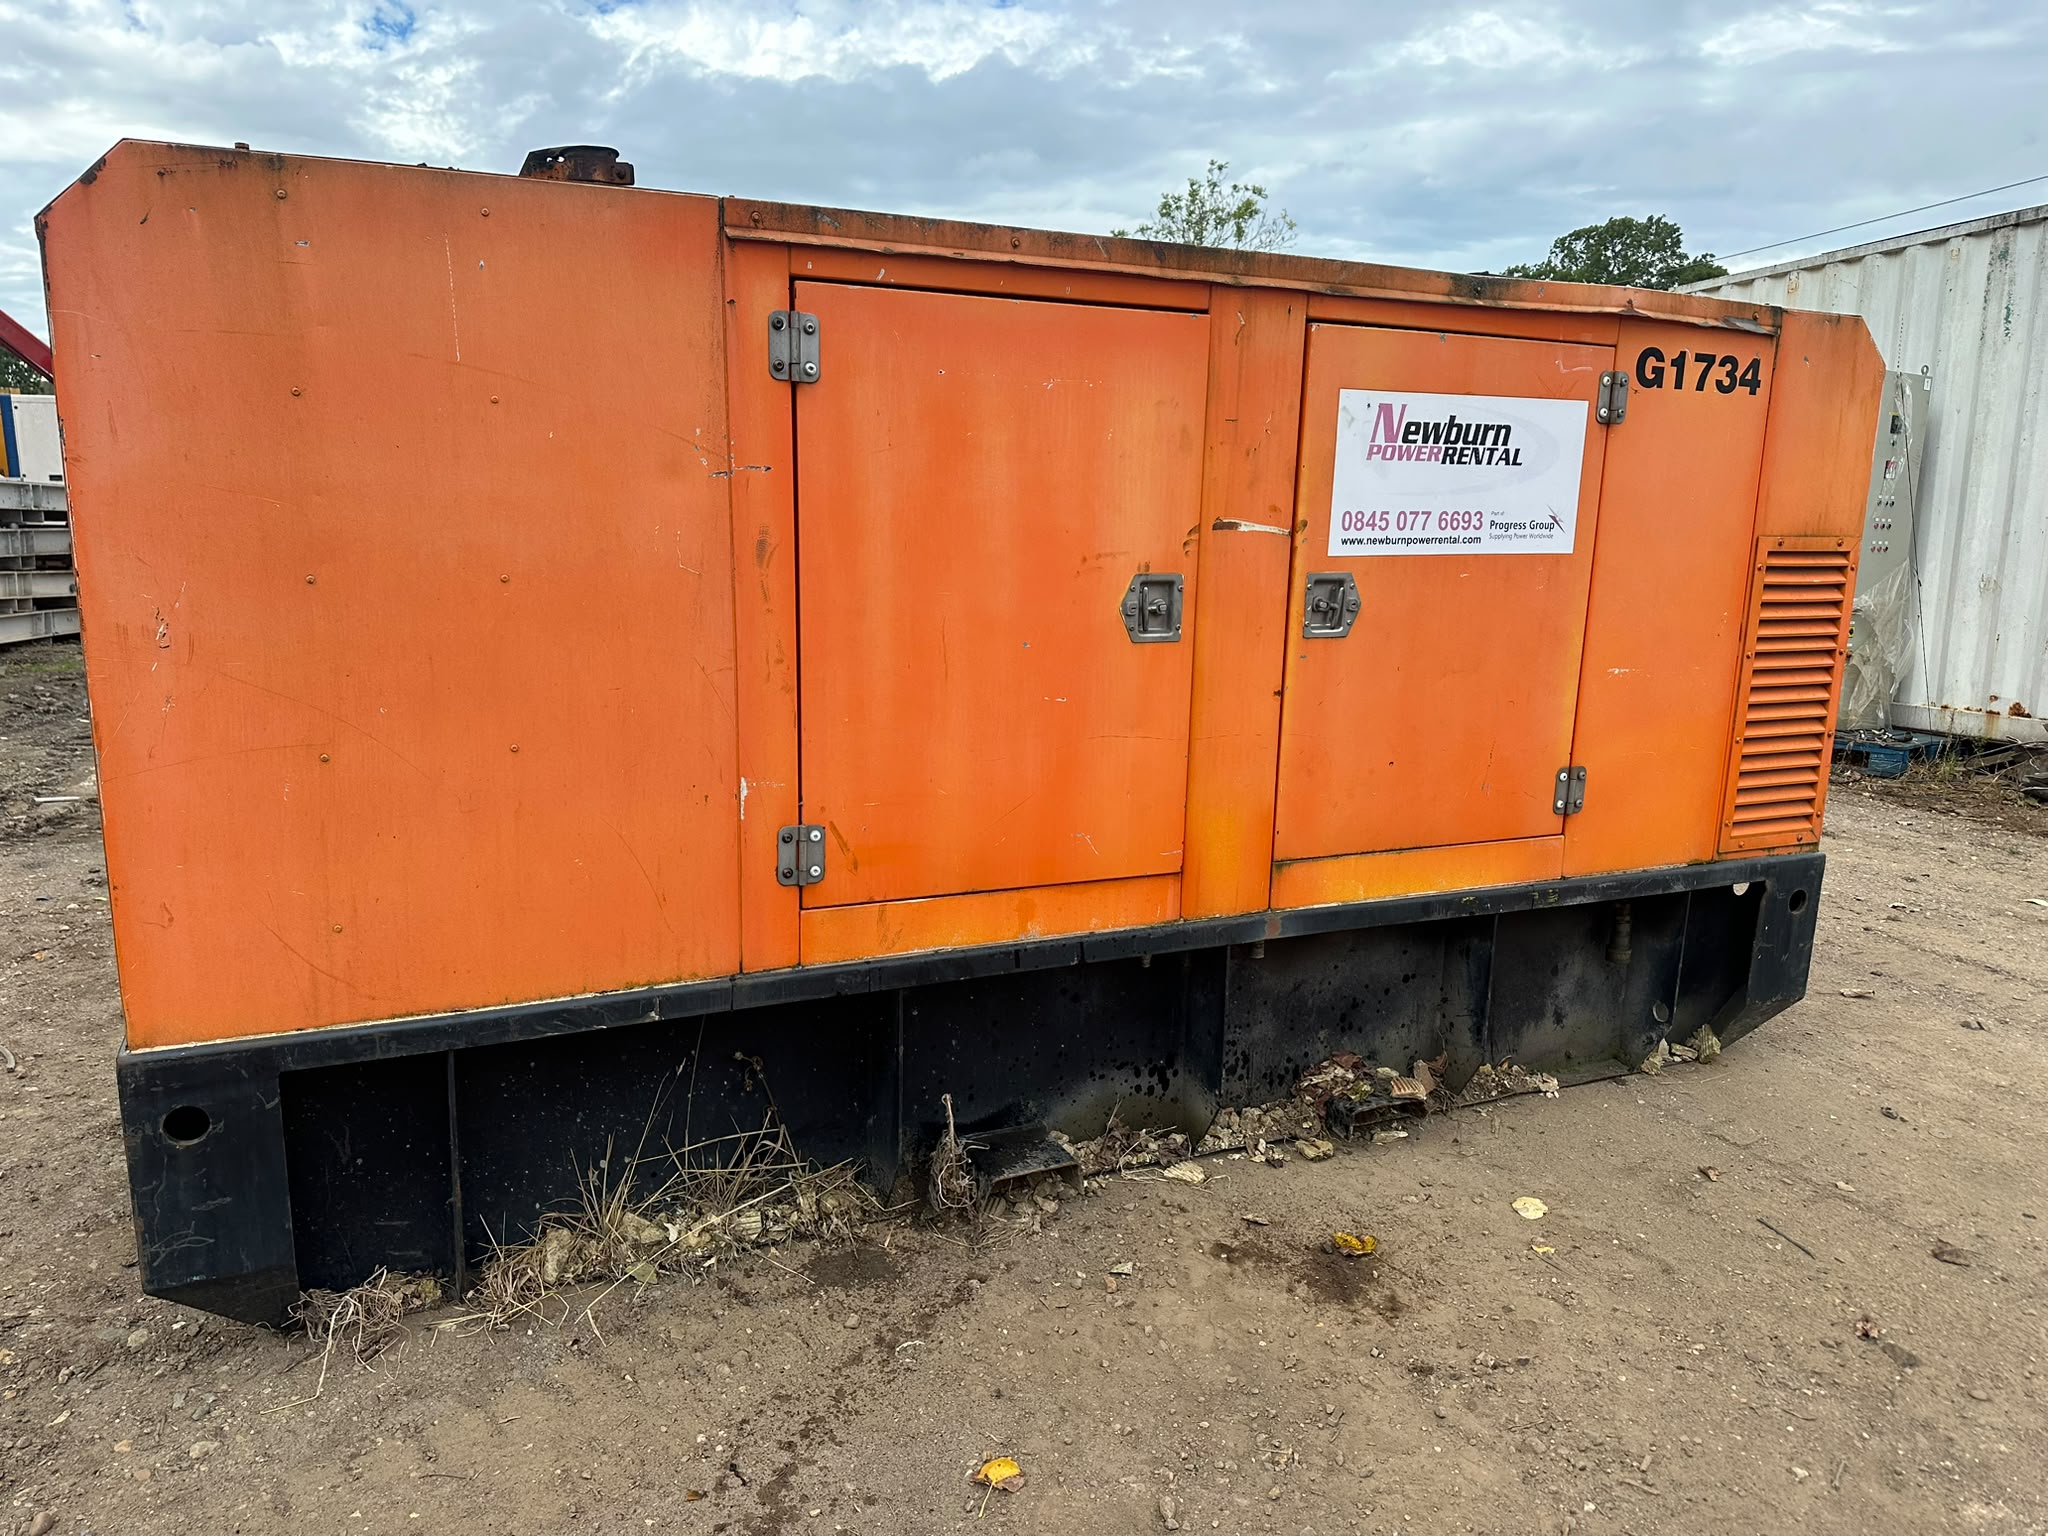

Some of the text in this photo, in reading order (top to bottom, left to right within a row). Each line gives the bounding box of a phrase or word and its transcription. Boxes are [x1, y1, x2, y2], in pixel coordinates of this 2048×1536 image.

[1635, 346, 1762, 396] G1734
[1370, 403, 1512, 446] Newburn
[1341, 510, 1483, 532] 0845 077 6693
[1489, 520, 1555, 533] Progress Group
[1341, 535, 1481, 548] www.newburnpowerrental.com
[1489, 532, 1554, 541] Supplying Power Worldwide
